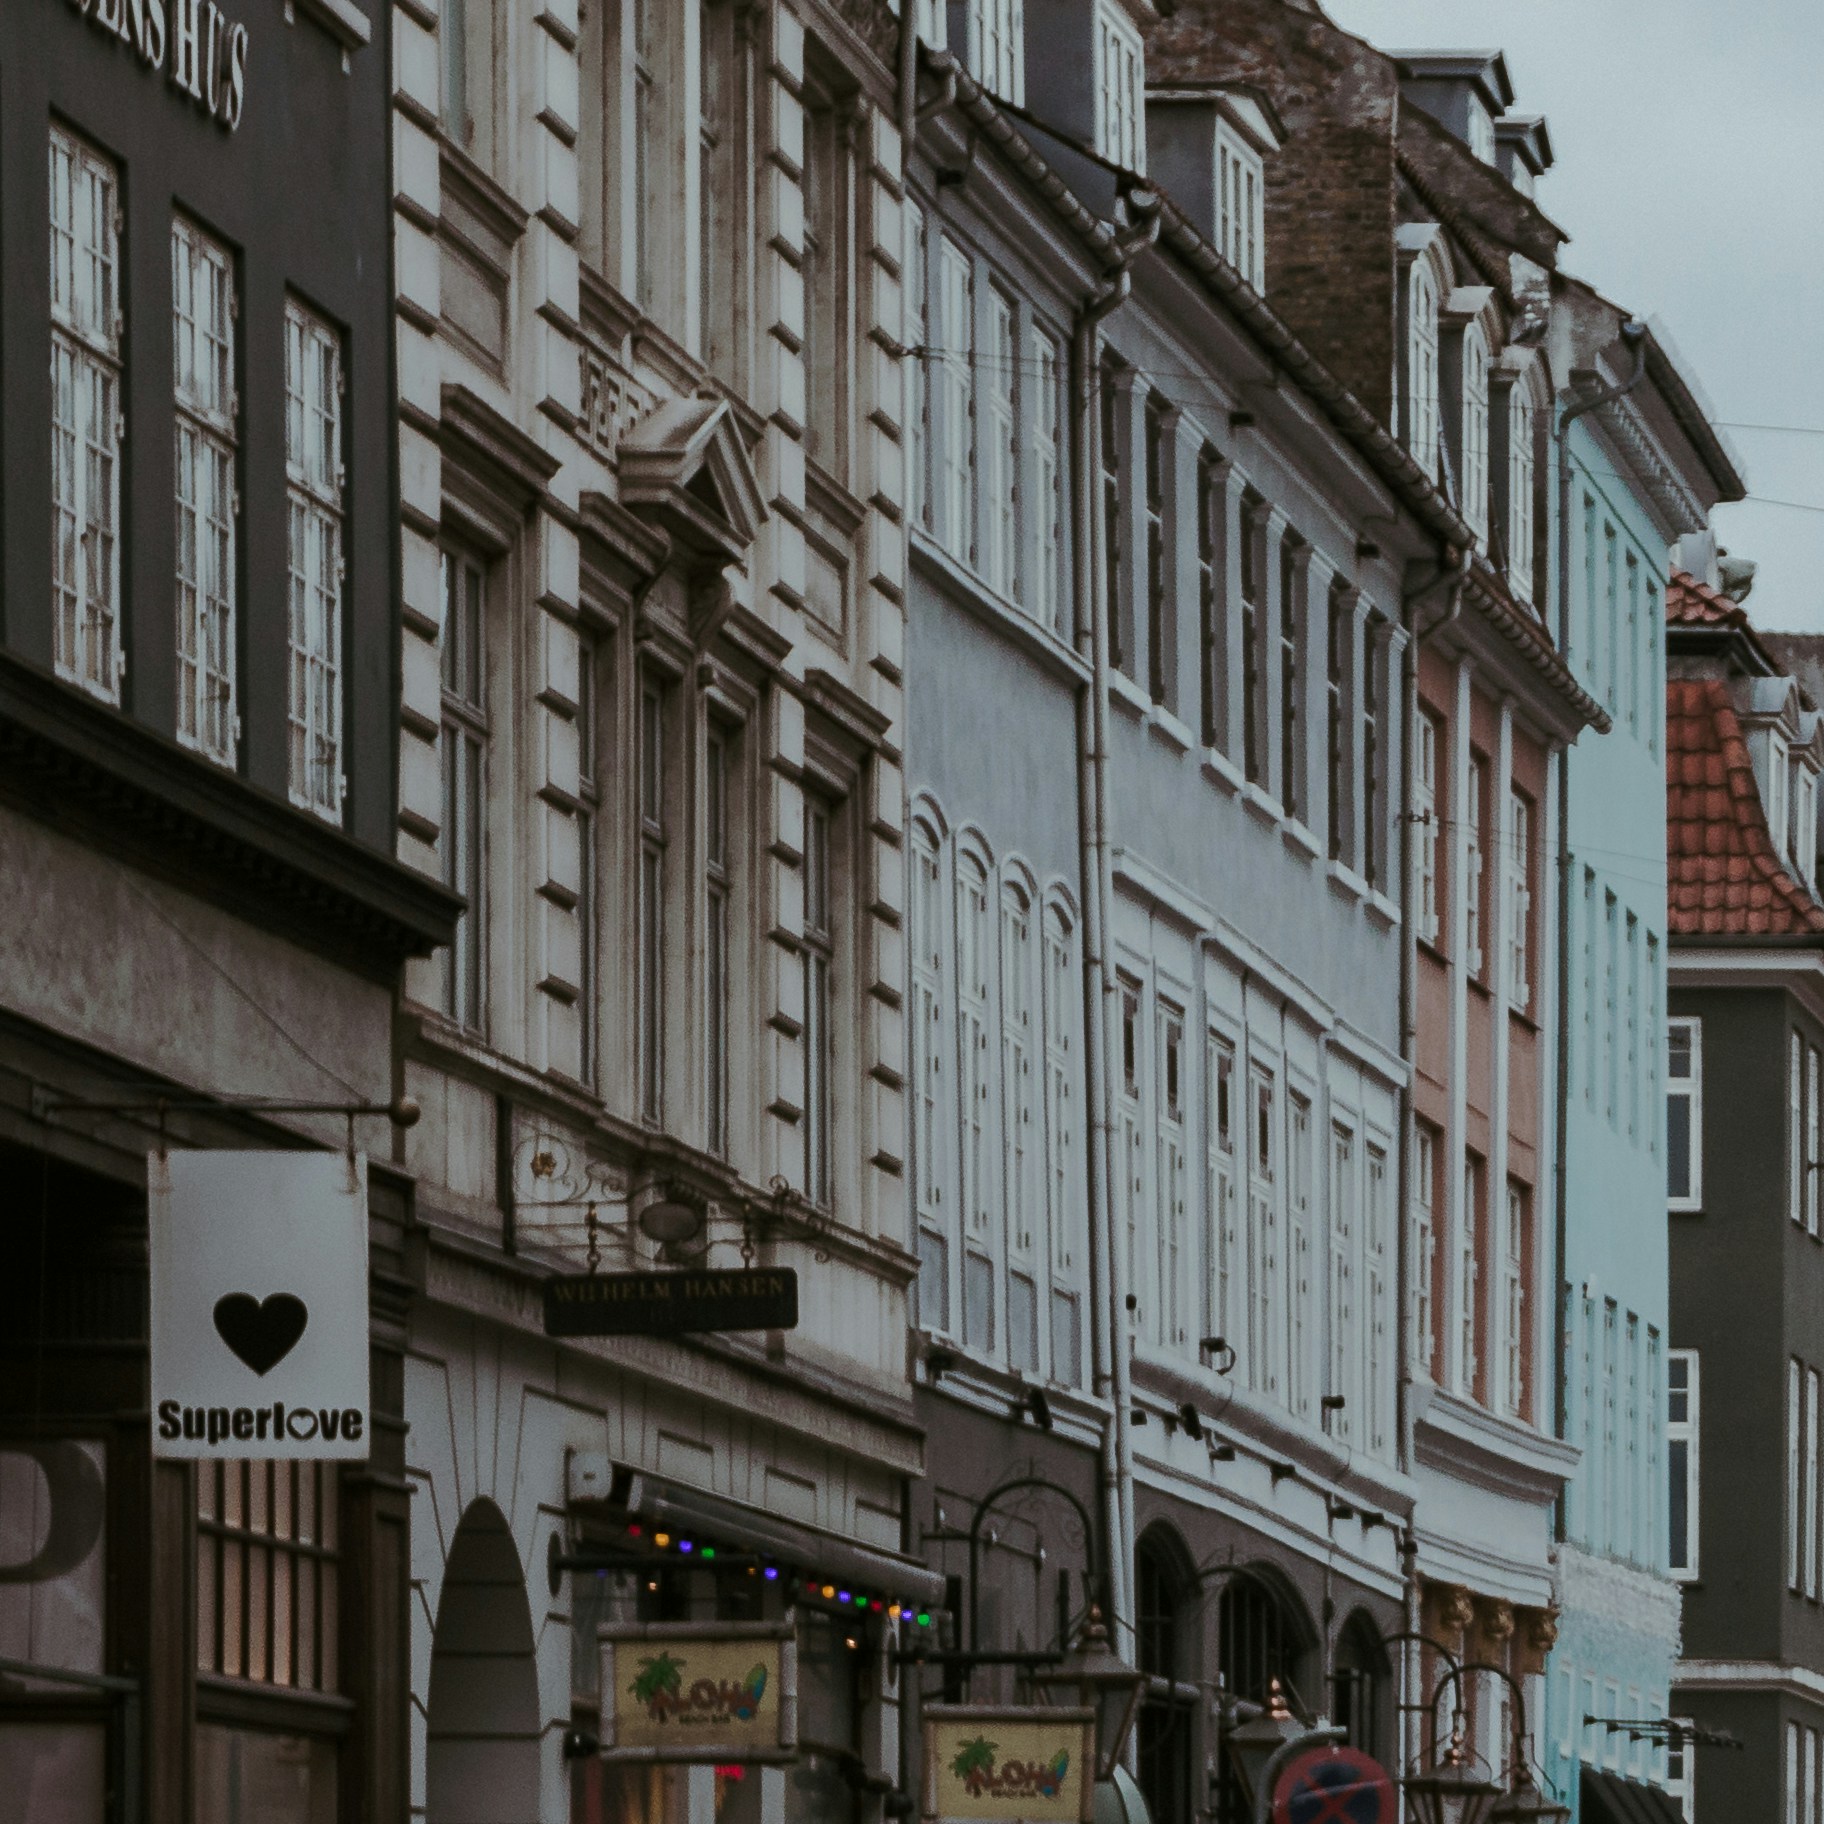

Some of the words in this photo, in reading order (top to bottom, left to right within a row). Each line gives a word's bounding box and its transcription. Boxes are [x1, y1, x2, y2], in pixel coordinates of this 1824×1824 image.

[554, 1279, 672, 1302] WILHELM
[684, 1275, 786, 1298] HANSEN
[158, 1400, 363, 1446] Superlove
